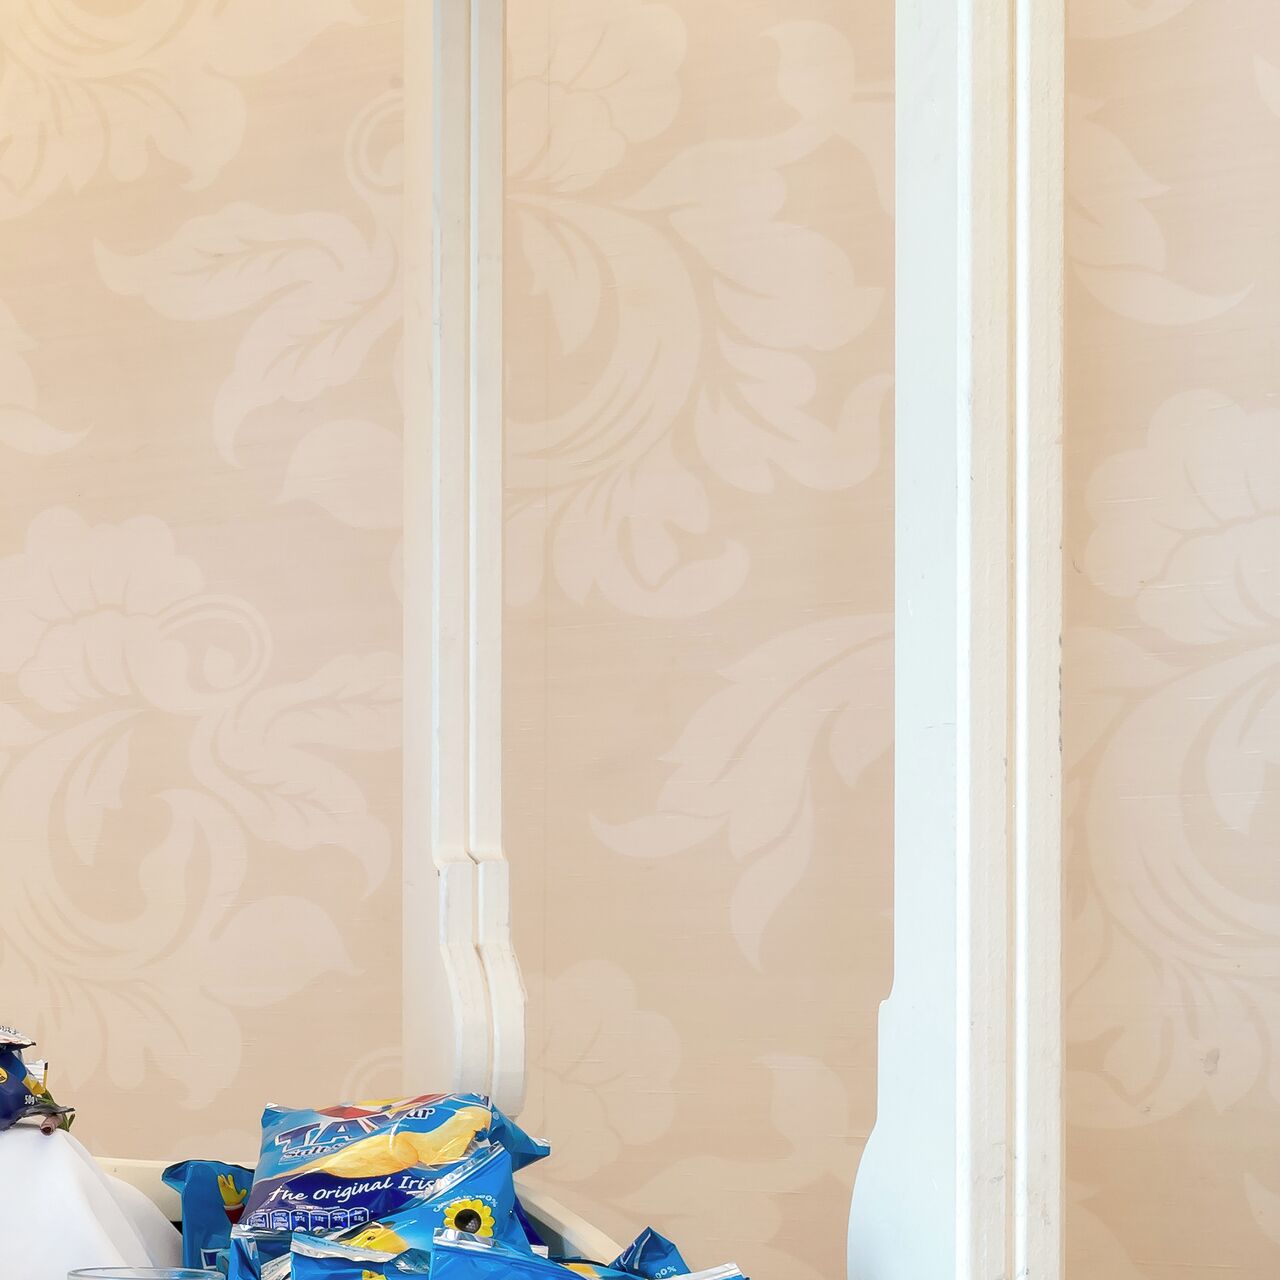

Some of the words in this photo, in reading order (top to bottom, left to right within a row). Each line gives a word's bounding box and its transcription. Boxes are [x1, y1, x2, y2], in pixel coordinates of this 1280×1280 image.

[268, 1184, 309, 1203] The
[312, 1177, 394, 1203] Original
[654, 1265, 677, 1280] 00%
